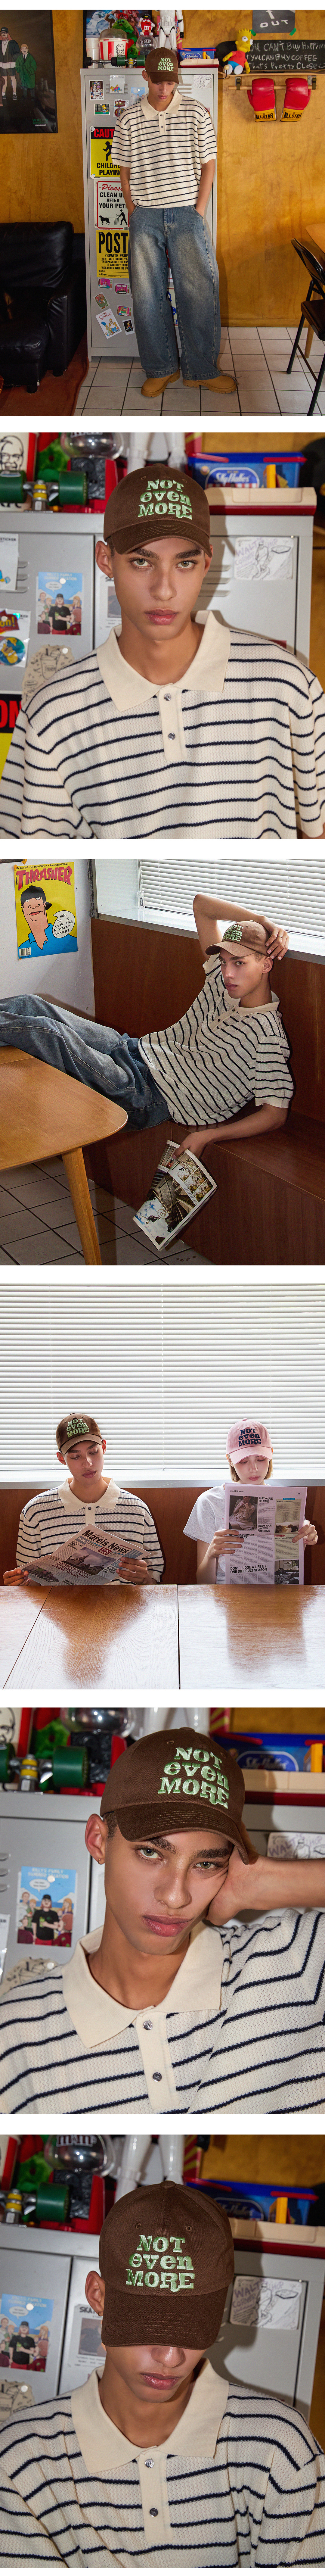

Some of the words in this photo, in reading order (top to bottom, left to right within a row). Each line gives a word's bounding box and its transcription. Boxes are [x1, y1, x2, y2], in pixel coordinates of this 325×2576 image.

[260, 20, 288, 28] OUT
[99, 232, 128, 254] POST
[146, 479, 184, 492] NOT
[140, 490, 192, 506] even
[138, 502, 192, 520] MORE
[16, 865, 73, 891] THRASHER
[67, 1423, 88, 1431] even
[67, 1427, 90, 1438] MORE
[238, 1439, 261, 1447] MORE
[82, 1530, 109, 1546] Mareis
[107, 1542, 129, 1553] News
[58, 1561, 78, 1570] HEADLINE
[173, 1747, 223, 1770] NOT
[164, 1761, 229, 1791] even
[158, 1777, 230, 1809] MORE
[136, 2235, 186, 2253] NOT
[129, 2253, 194, 2270] even
[125, 2269, 195, 2292] MORE
